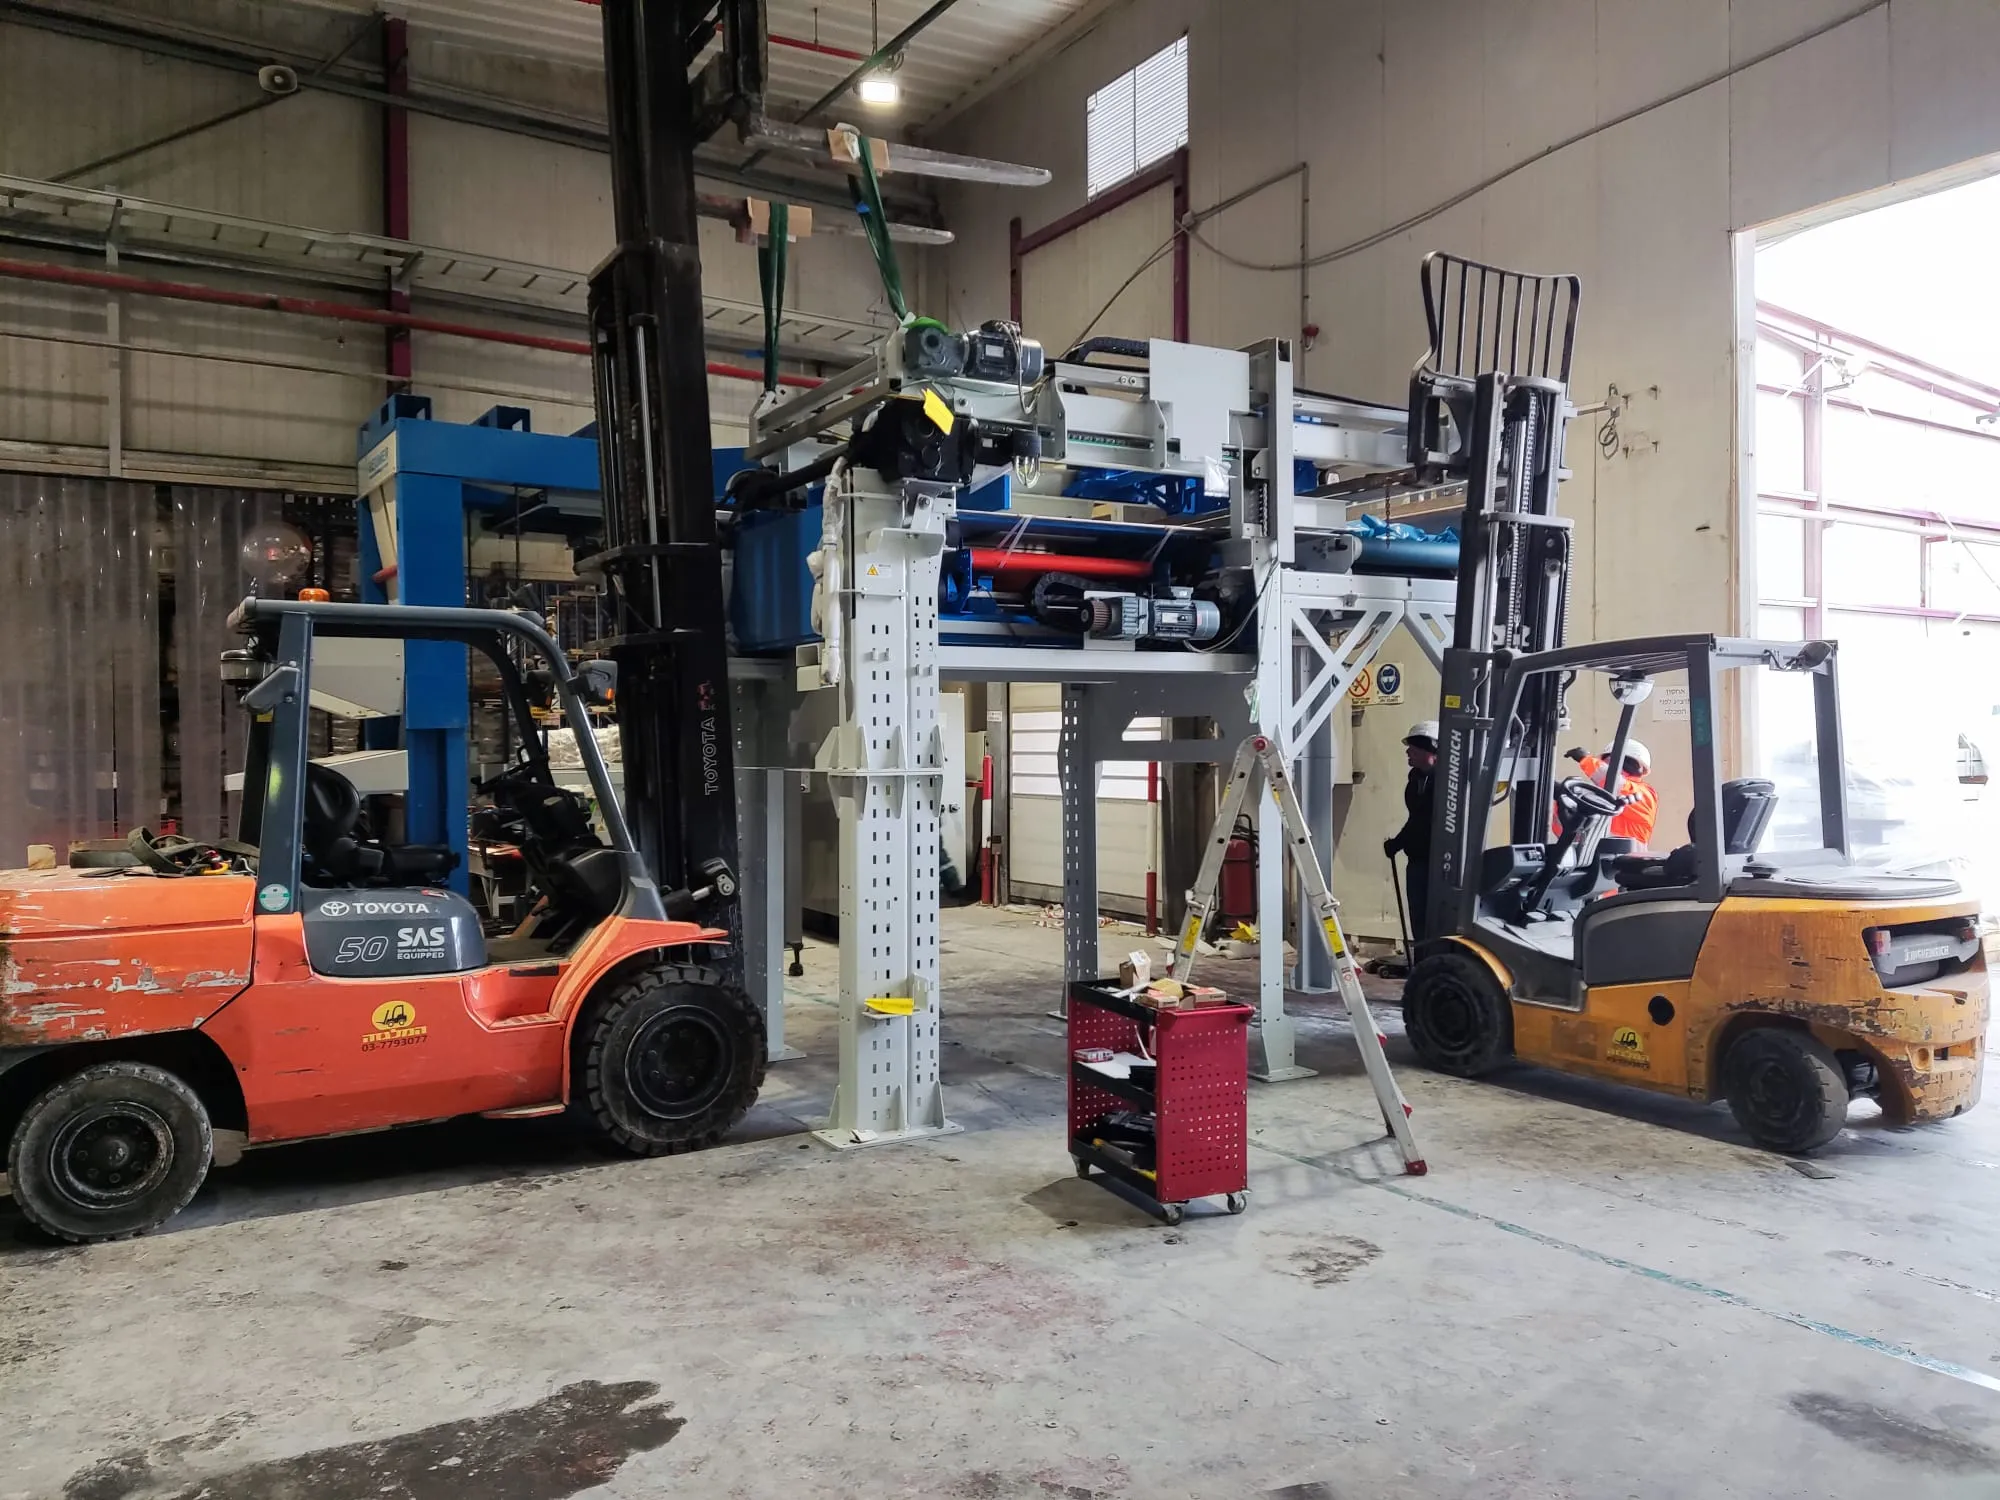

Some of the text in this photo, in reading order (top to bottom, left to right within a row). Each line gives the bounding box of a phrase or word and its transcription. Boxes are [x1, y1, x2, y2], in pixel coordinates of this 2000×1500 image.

[701, 717, 719, 796] TOYOTA
[1445, 729, 1462, 835] UNGHEINRICH
[352, 902, 430, 915] TOYOTA
[397, 926, 445, 948] SAS
[335, 936, 389, 964] 50
[397, 952, 445, 960] EQUIPPED
[361, 1035, 428, 1052] 03-7793077
